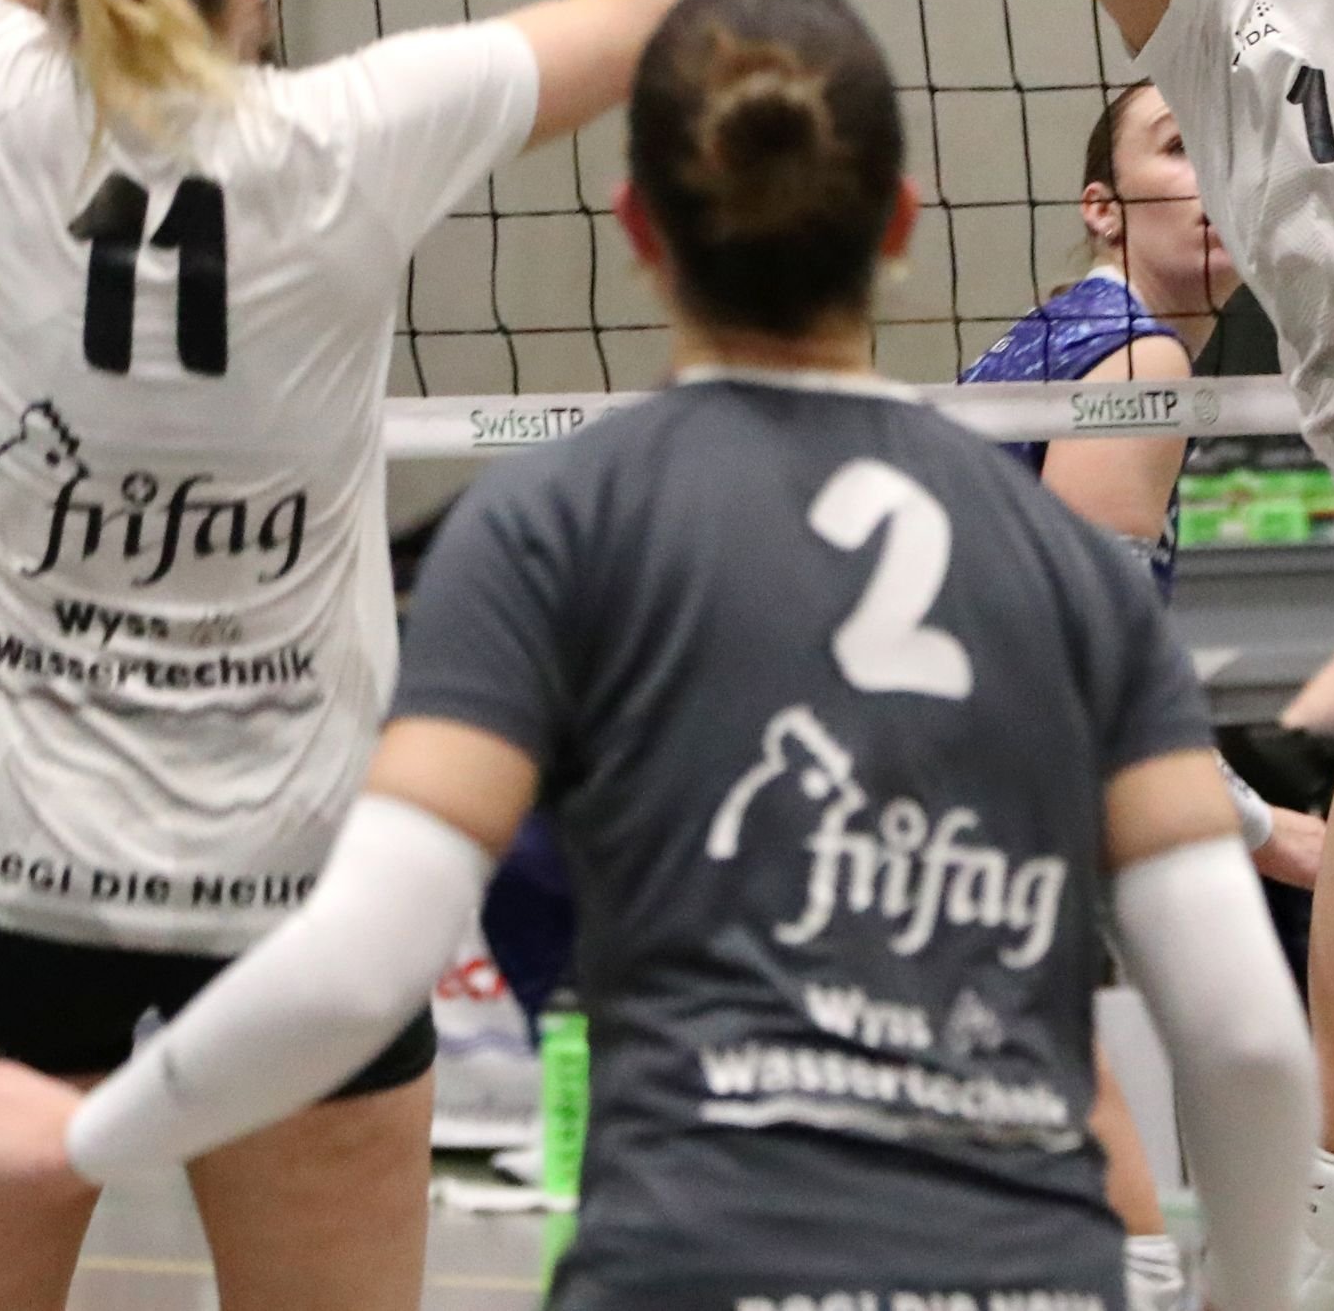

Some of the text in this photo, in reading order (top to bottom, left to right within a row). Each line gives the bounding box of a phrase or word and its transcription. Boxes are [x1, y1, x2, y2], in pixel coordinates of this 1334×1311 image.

[68, 172, 229, 376] 11
[21, 465, 308, 585] frifag
[808, 459, 974, 700] 2
[53, 599, 169, 645] Wyss
[773, 797, 1067, 970] frifag
